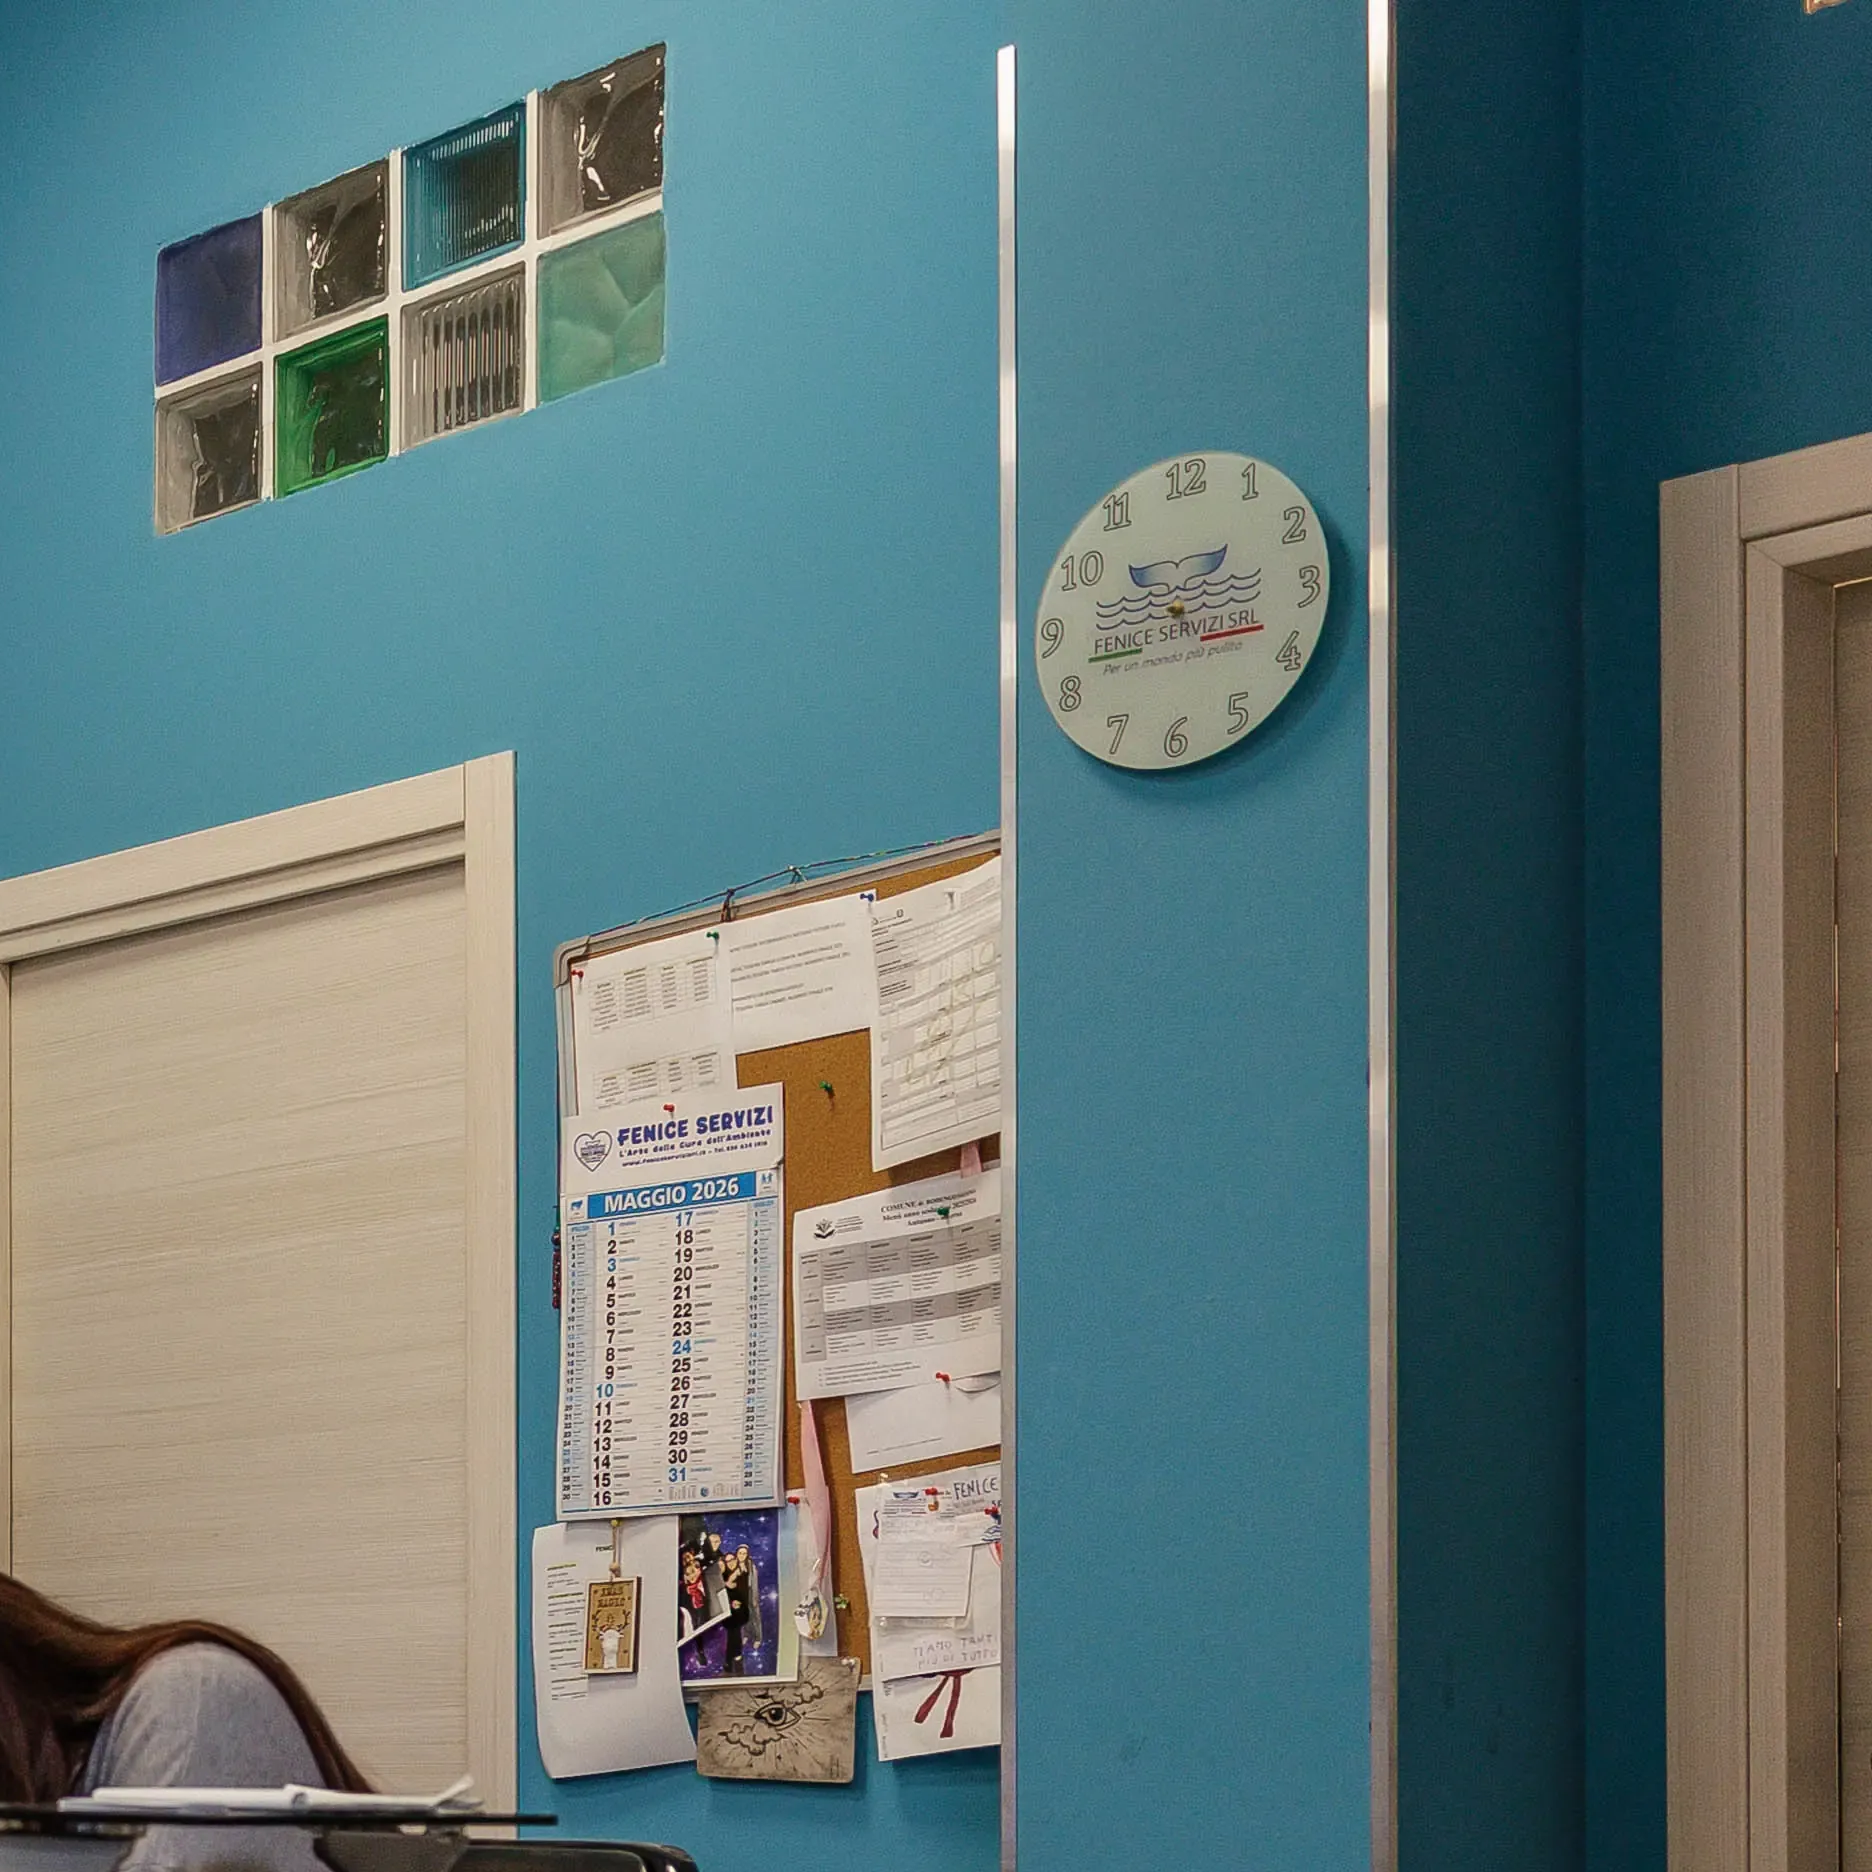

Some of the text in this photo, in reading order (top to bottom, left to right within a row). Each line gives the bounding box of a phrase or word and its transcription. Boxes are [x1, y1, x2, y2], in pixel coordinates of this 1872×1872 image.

[1166, 459, 1206, 500] 12
[1243, 463, 1258, 500] 1
[1103, 493, 1131, 530] 11
[1282, 506, 1307, 544] 2
[1061, 551, 1104, 591] 10
[1298, 565, 1320, 608] 3
[1041, 618, 1064, 658] 9
[1095, 609, 1260, 654] FENICE SERVIZI SRL
[1277, 631, 1300, 671] 4
[1059, 676, 1081, 712] 8
[1227, 692, 1248, 734] 5
[1107, 715, 1129, 754] 7
[1164, 716, 1188, 758] 6
[617, 1105, 773, 1145] FENICE SERVIZI
[604, 1177, 739, 1213] MAGGIO 2026
[676, 1212, 693, 1226] 17
[676, 1230, 693, 1245] 18
[675, 1248, 692, 1263] 19
[673, 1266, 692, 1282] 20
[673, 1285, 691, 1300] 21
[673, 1303, 692, 1318] 22
[673, 1321, 692, 1336] 23
[672, 1340, 691, 1354] 24
[672, 1358, 691, 1373] 25
[596, 1384, 613, 1398] 10
[671, 1376, 690, 1391] 26
[595, 1402, 611, 1416] 11
[670, 1394, 689, 1409] 27
[594, 1420, 612, 1434] 12
[669, 1412, 689, 1427] 28
[594, 1438, 611, 1452] 13
[669, 1430, 688, 1445] 29
[594, 1456, 610, 1470] 14
[668, 1449, 687, 1464] 30
[594, 1473, 610, 1488] 15
[669, 1468, 686, 1482] 31
[954, 1477, 998, 1499] FENICE
[594, 1491, 611, 1506] 16
